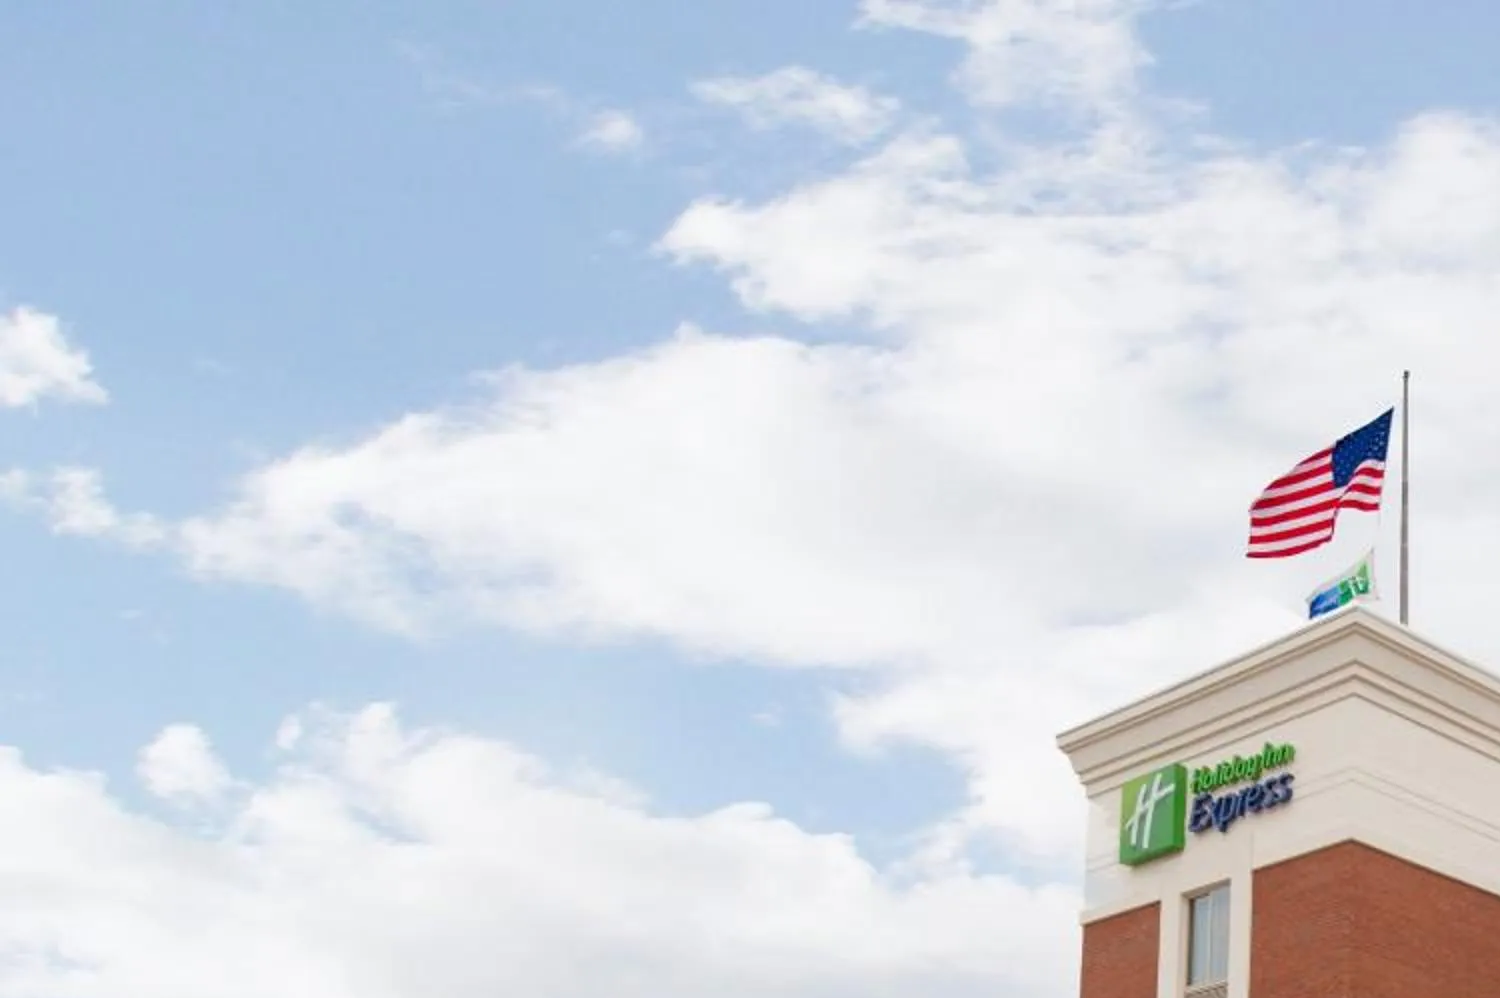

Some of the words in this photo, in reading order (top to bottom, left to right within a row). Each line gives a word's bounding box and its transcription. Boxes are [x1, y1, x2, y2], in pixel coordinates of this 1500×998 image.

[1191, 753, 1262, 795] Holiday
[1262, 741, 1295, 769] Inn
[1188, 773, 1294, 833] Express
